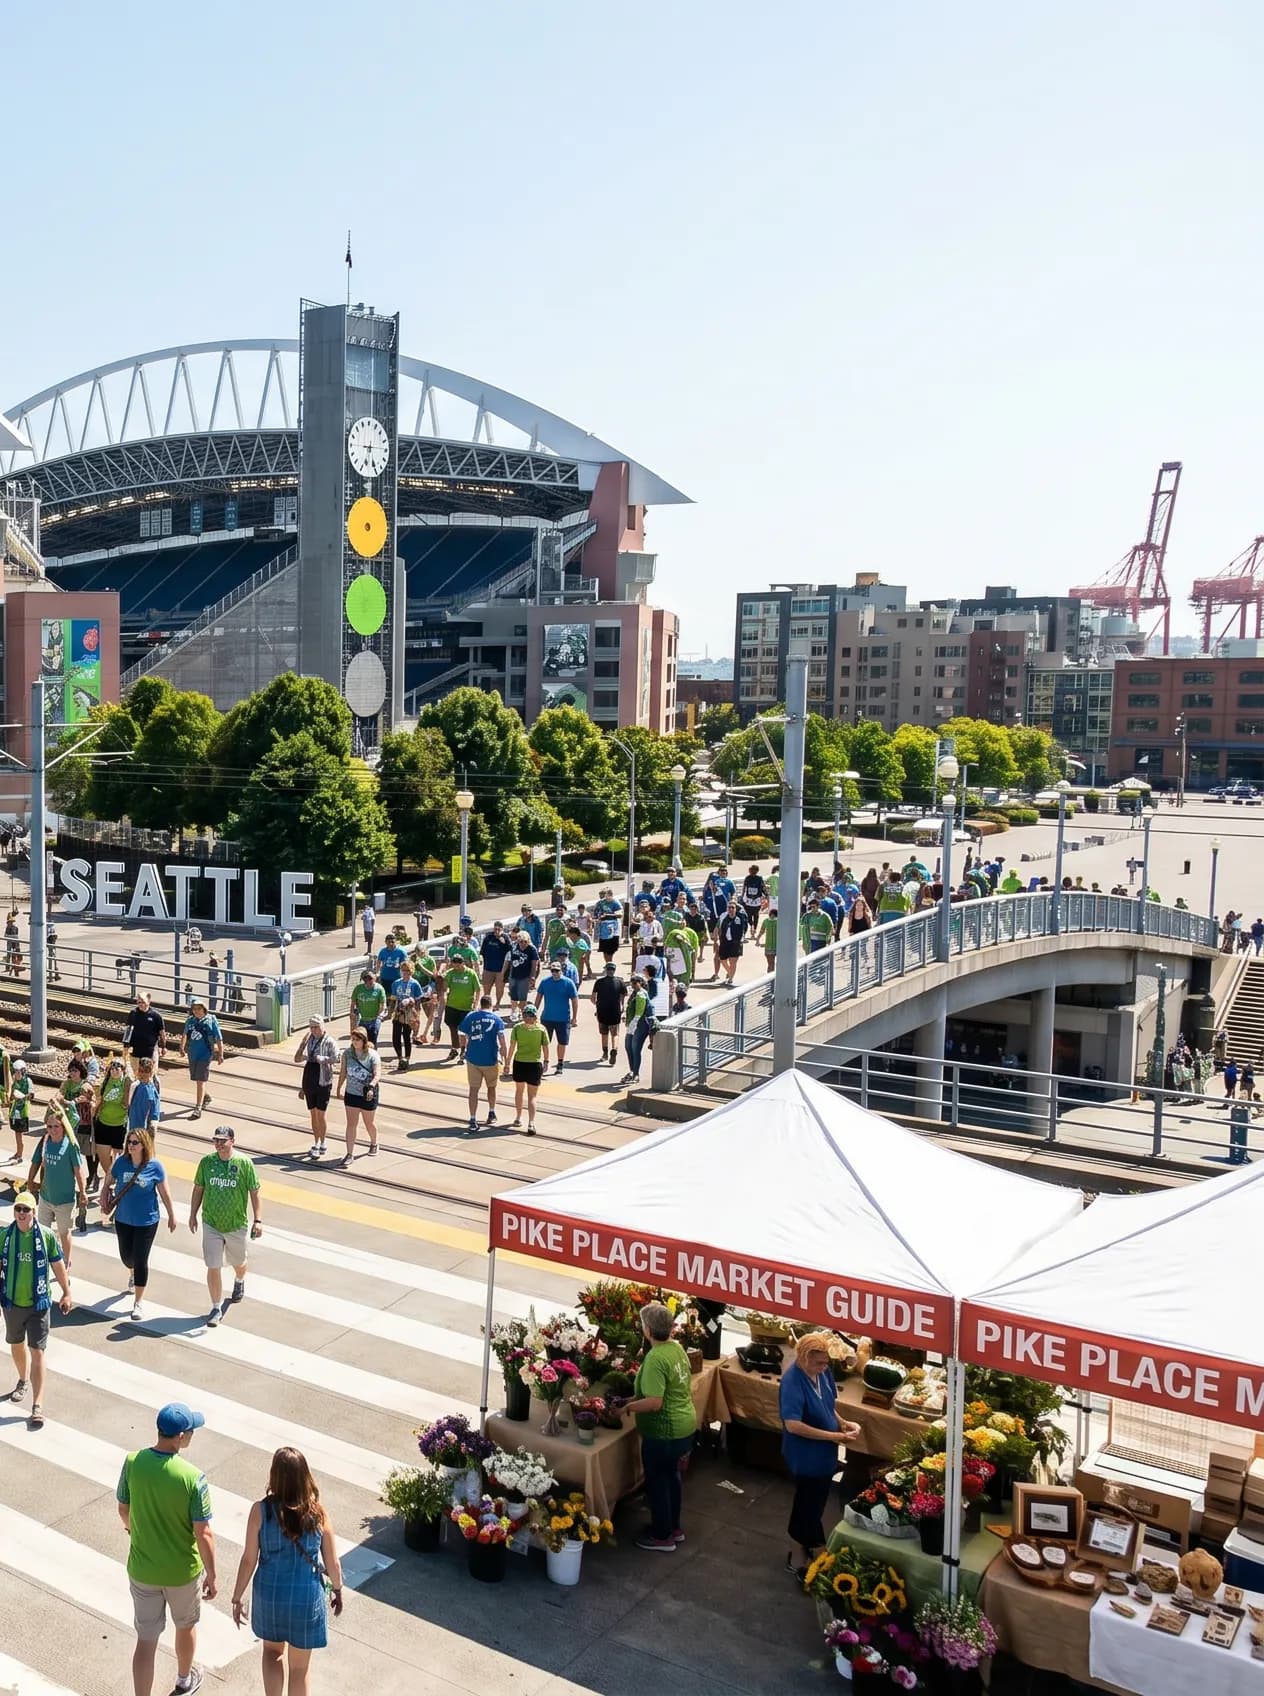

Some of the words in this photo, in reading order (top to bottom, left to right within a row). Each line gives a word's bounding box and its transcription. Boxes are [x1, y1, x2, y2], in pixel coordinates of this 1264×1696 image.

[58, 858, 314, 931] SEATTLE
[502, 1212, 564, 1253] PIKE
[573, 1228, 667, 1277] PLACE
[677, 1251, 815, 1310] MARKET
[826, 1285, 935, 1339] GUIDE
[976, 1319, 1067, 1372] PIKE
[1080, 1342, 1220, 1407] PLACE
